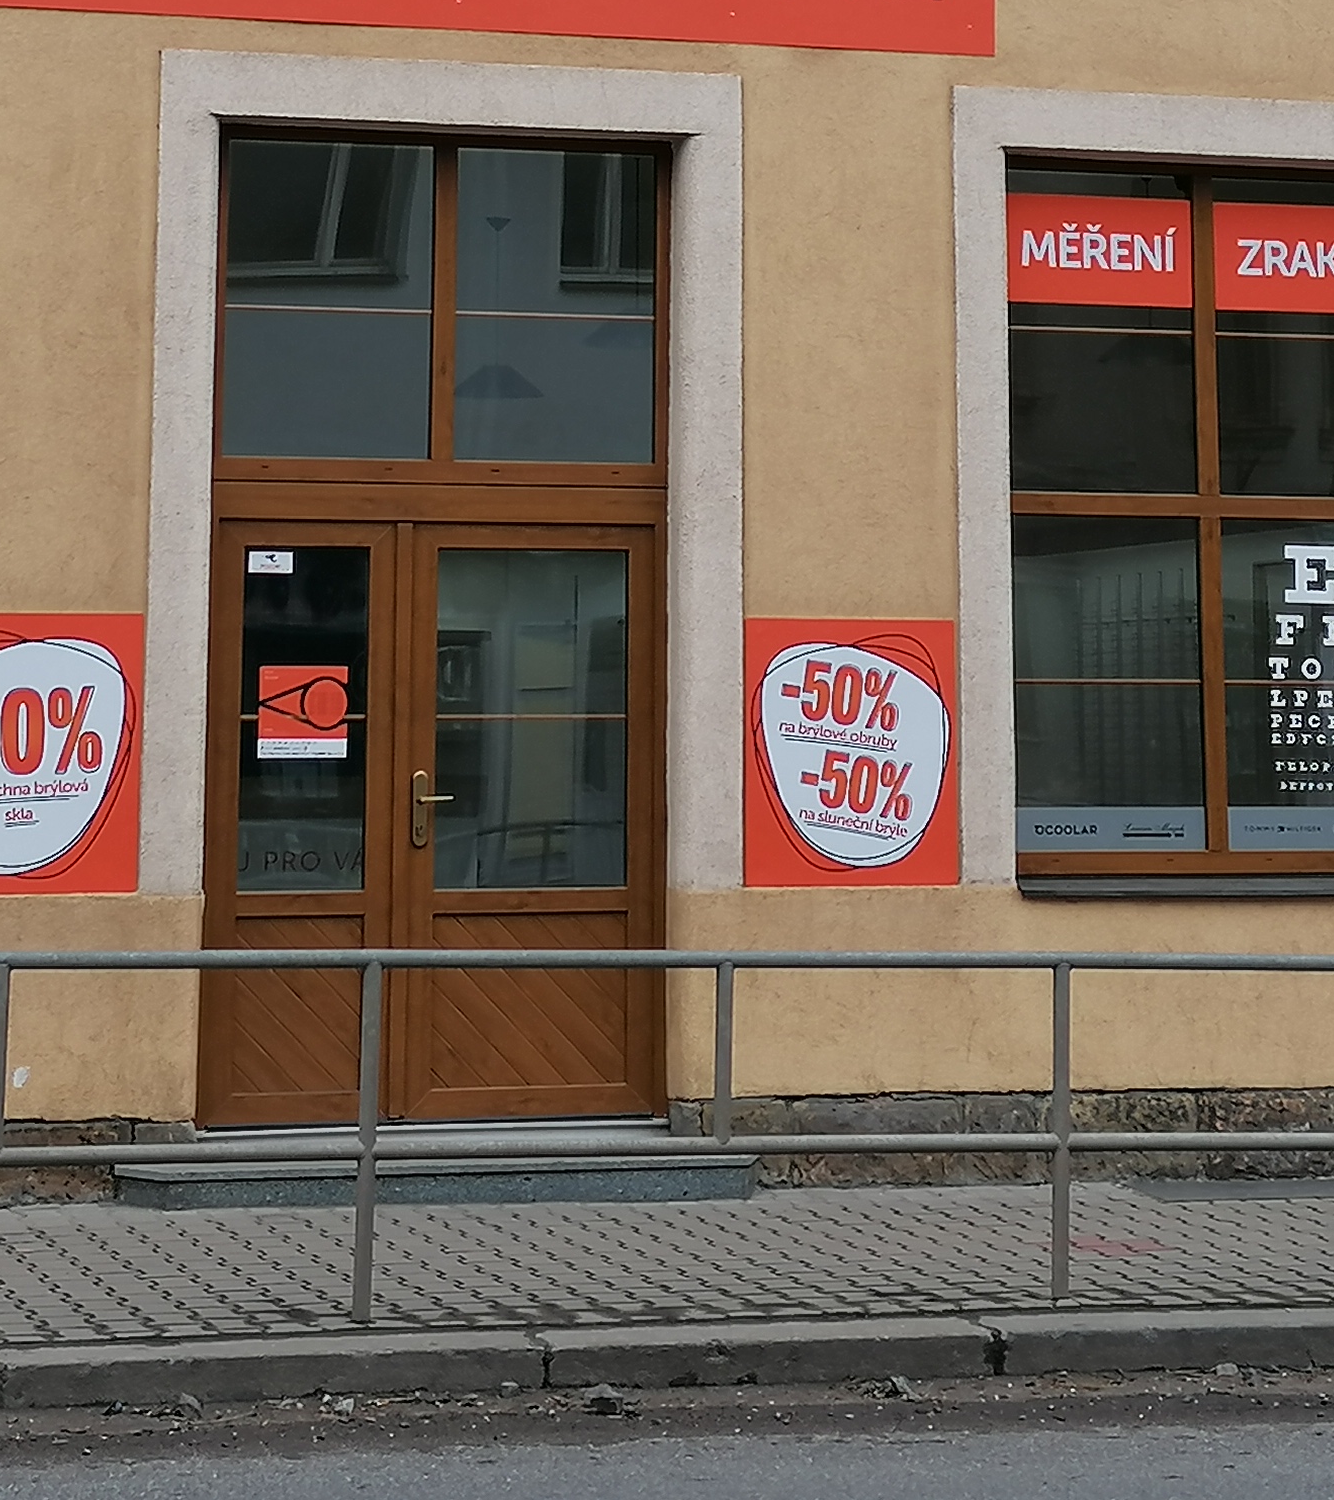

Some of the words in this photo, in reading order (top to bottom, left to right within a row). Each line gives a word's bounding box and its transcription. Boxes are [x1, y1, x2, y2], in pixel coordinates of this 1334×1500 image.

[1020, 222, 1176, 273] MĚŘENÍ
[1276, 615, 1304, 645] F
[781, 659, 900, 731] -50%
[779, 720, 795, 732] na
[798, 723, 847, 741] brýlové
[850, 730, 898, 750] obruby
[34, 778, 89, 798] brýlová
[800, 749, 913, 821] -50%
[5, 808, 33, 821] skla
[799, 808, 815, 820] na
[817, 810, 874, 831] sluneční
[876, 821, 909, 838] brýle
[264, 851, 322, 873] PRO
